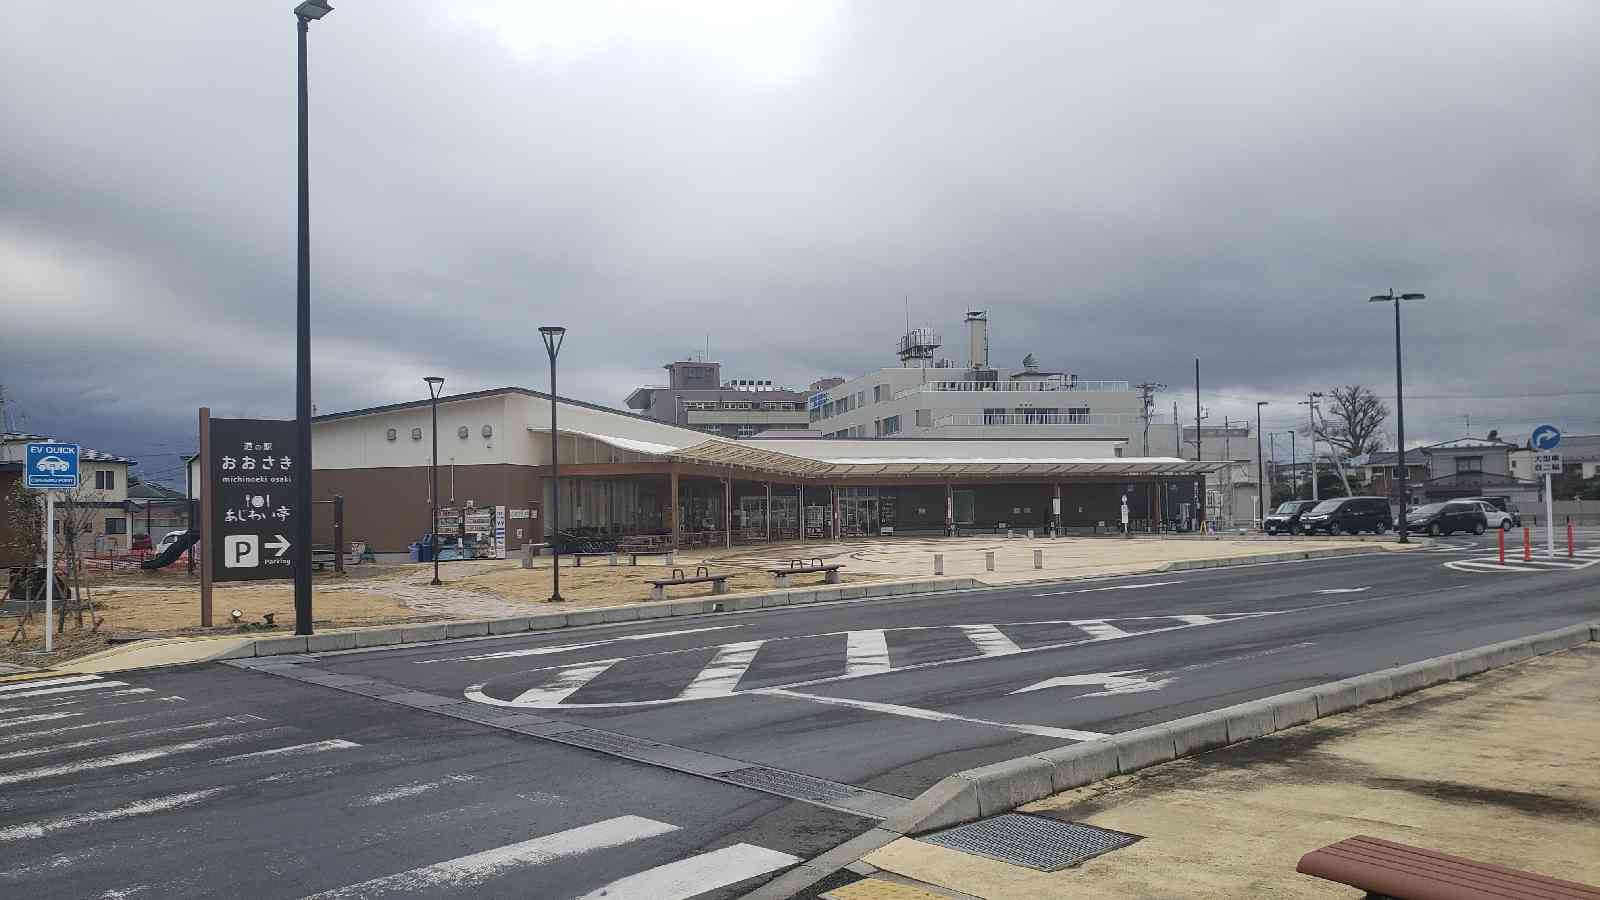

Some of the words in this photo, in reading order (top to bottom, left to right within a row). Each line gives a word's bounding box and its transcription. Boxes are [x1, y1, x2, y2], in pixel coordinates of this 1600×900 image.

[30, 446, 44, 454] EV
[45, 446, 76, 455] QUICK
[222, 455, 293, 470] おおさき
[235, 541, 251, 564] P
